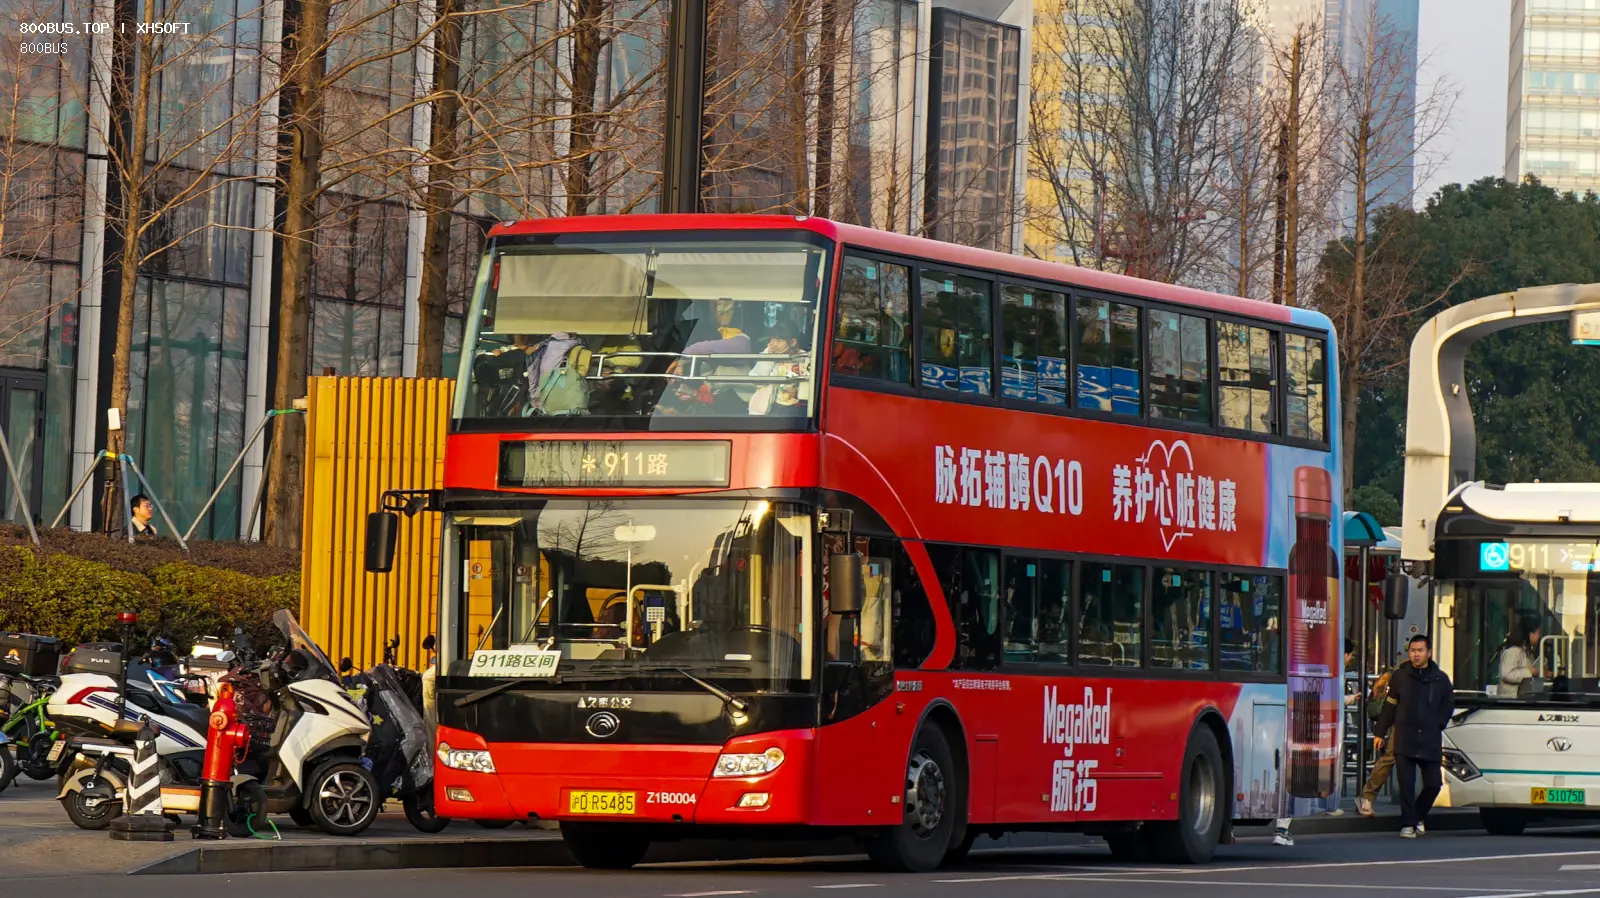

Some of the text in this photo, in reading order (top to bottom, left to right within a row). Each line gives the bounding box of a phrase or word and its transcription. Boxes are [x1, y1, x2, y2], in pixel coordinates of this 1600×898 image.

[935, 444, 1237, 532] 脉拓辅酶Q10 养护心脏健康
[1509, 543, 1549, 570] 911
[476, 654, 556, 668] 911路区间
[1043, 685, 1111, 757] MegaRed
[646, 791, 697, 804] Z1B0004
[1050, 759, 1099, 812] 脉拓
